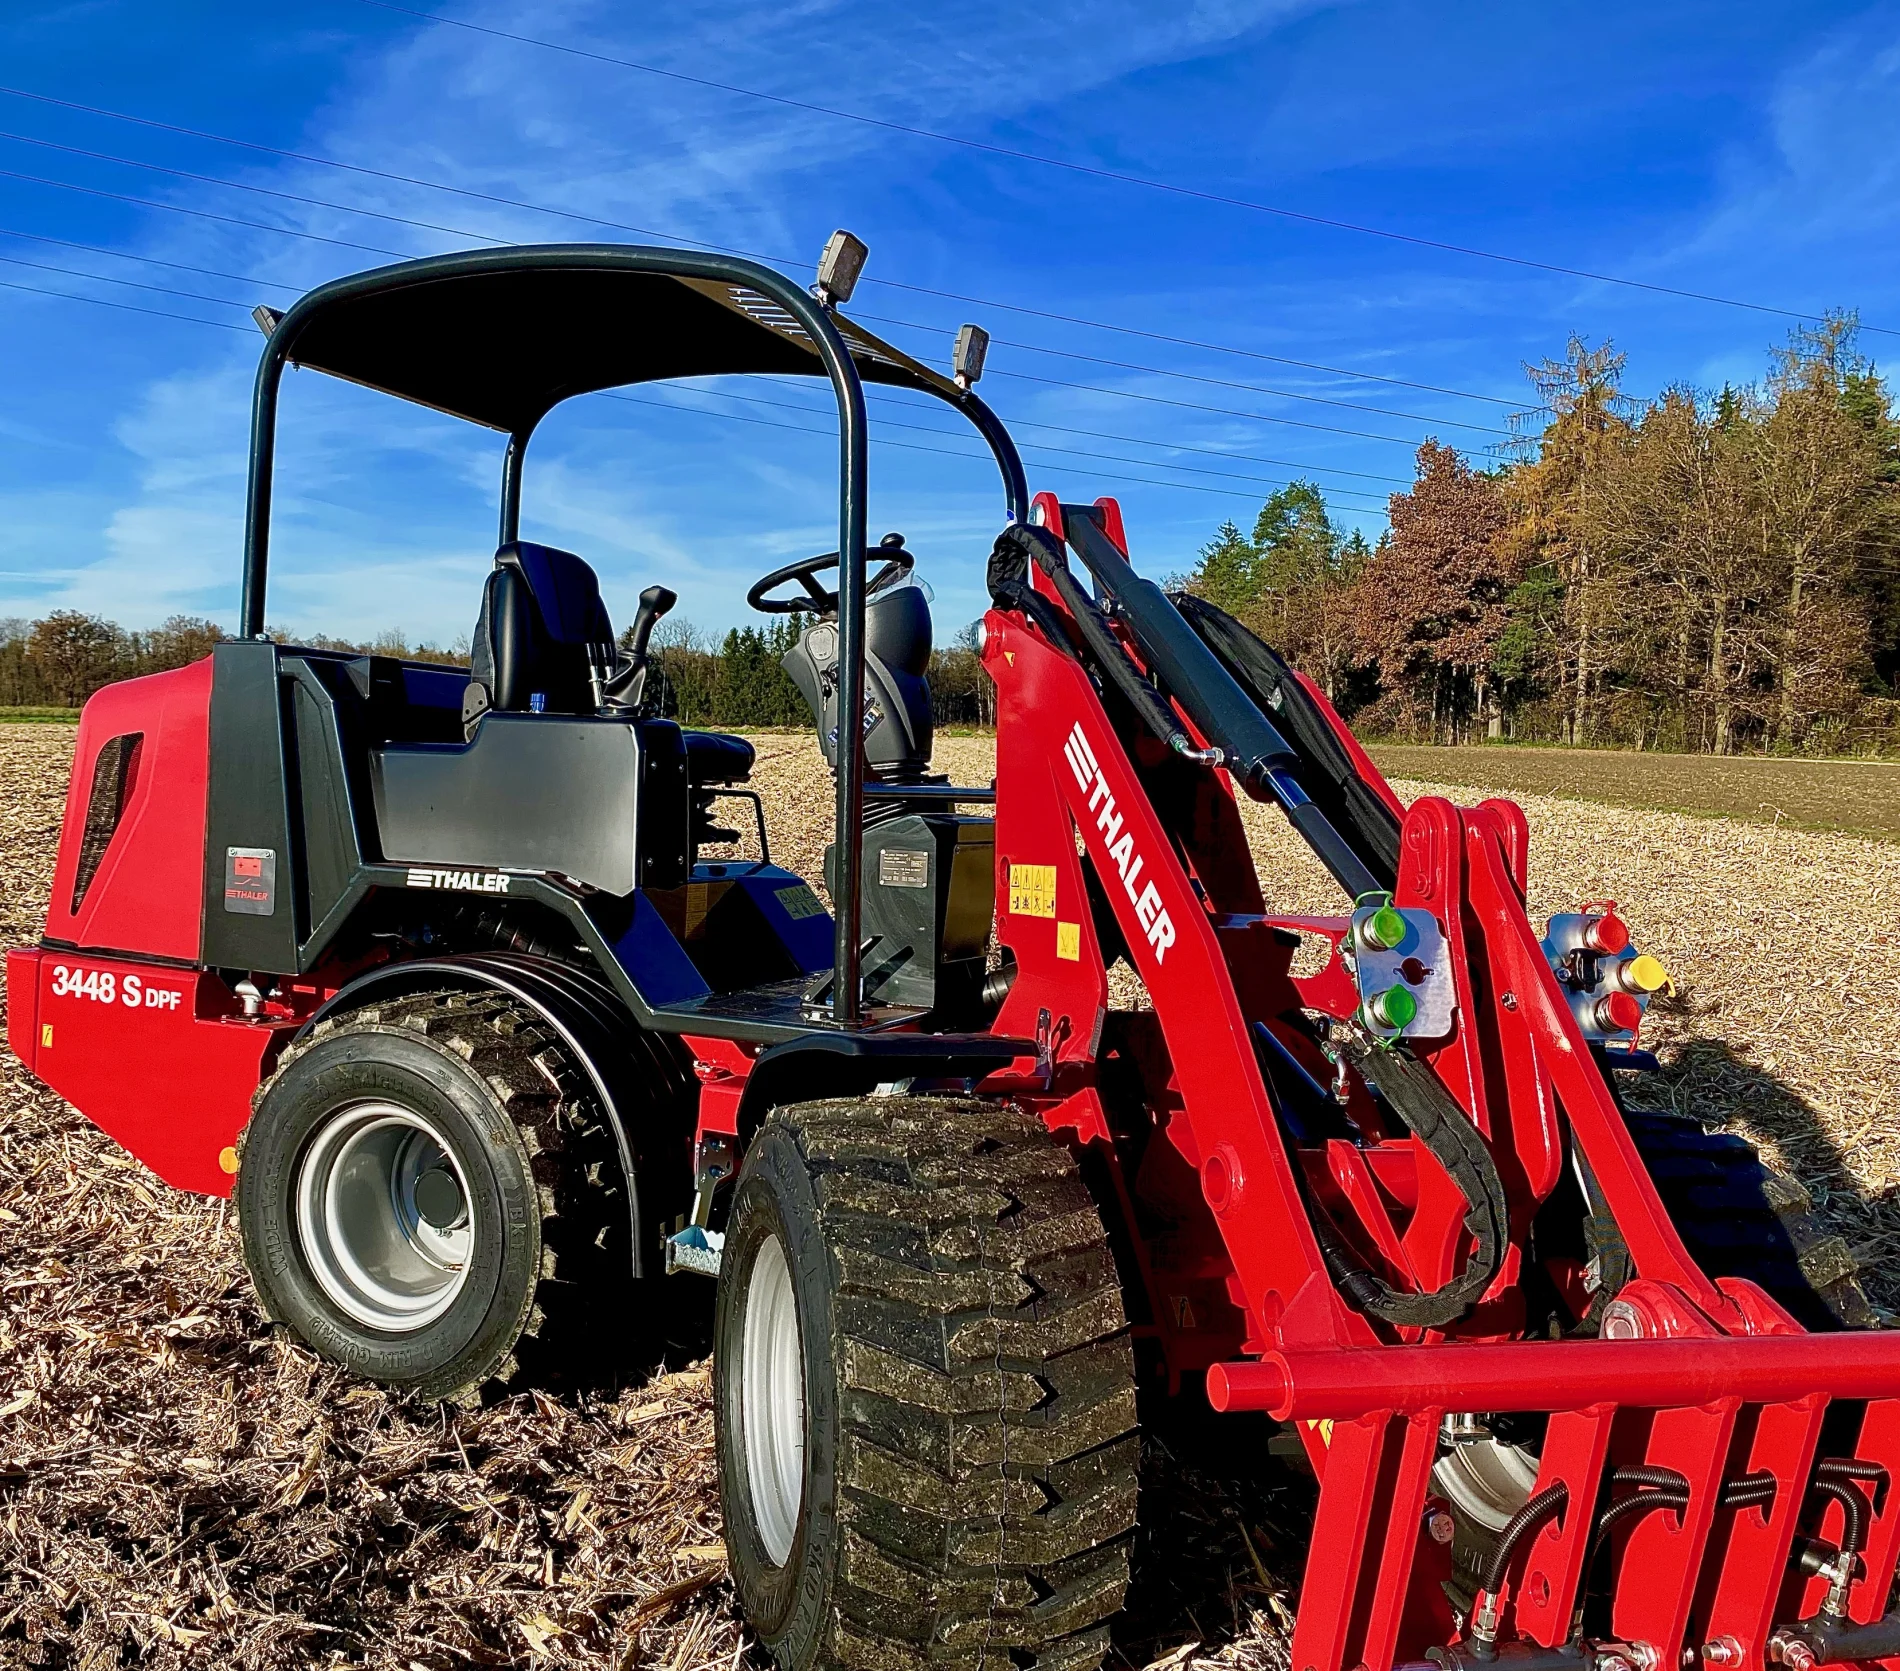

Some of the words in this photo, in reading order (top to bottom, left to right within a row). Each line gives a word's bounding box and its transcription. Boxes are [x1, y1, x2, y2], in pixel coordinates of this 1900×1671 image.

[52, 965, 116, 1004] 3448
[121, 975, 142, 1008] S
[145, 988, 182, 1011] DPF
[264, 1219, 289, 1277] WIDE
[508, 1206, 527, 1254] BKT
[308, 1316, 371, 1365] GUARD
[379, 1350, 412, 1368] RIM
[803, 1541, 825, 1602] SKID
